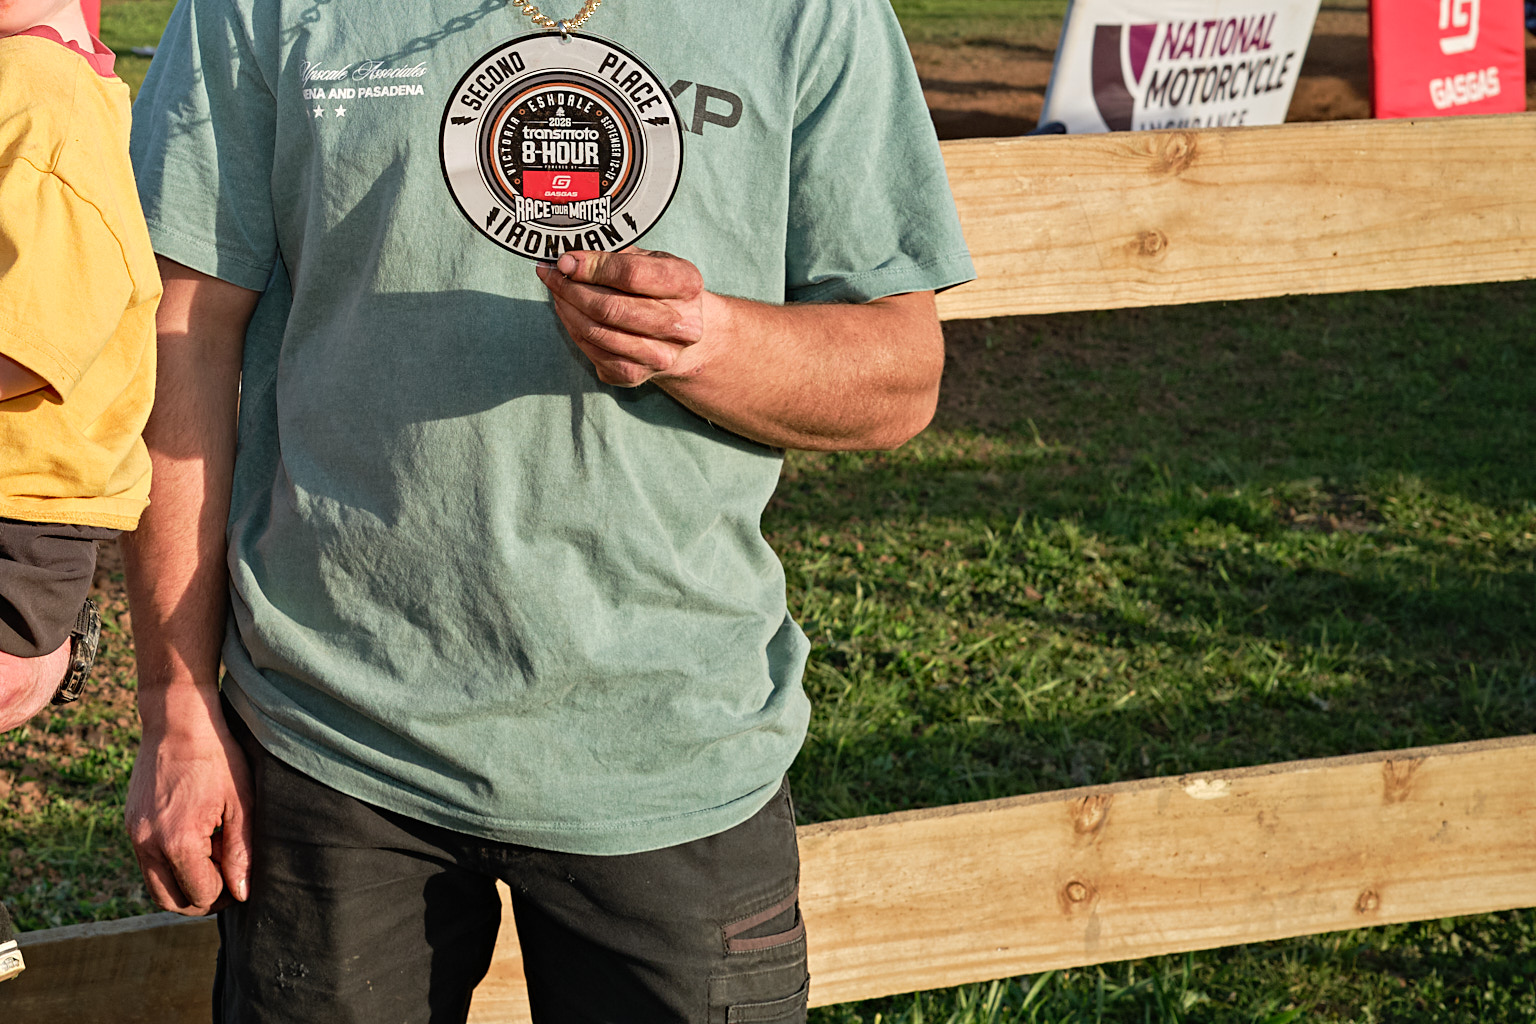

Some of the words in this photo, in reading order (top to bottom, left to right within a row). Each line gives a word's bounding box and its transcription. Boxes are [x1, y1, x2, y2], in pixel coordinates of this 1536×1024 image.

[1158, 13, 1277, 61] NATIONAL
[300, 60, 353, 87] Upscale
[351, 59, 427, 82] Associates
[460, 51, 526, 111] SECOND
[597, 52, 662, 114] PLACE
[1145, 52, 1295, 108] MOTORCYCLE
[1429, 66, 1501, 110] GASGAS
[328, 88, 356, 100] AND
[357, 84, 424, 99] PASADENA
[522, 125, 600, 140] transmoto
[548, 117, 571, 127] 2026
[600, 116, 621, 157] SEPTEMBER
[501, 117, 520, 176] VICTORIA
[522, 141, 600, 165] 8-HOUR
[605, 159, 621, 181] 12-13
[515, 195, 552, 223] RACE
[551, 205, 569, 215] YOUR
[568, 195, 611, 225] MATES!
[494, 216, 624, 258] IRONMAN
